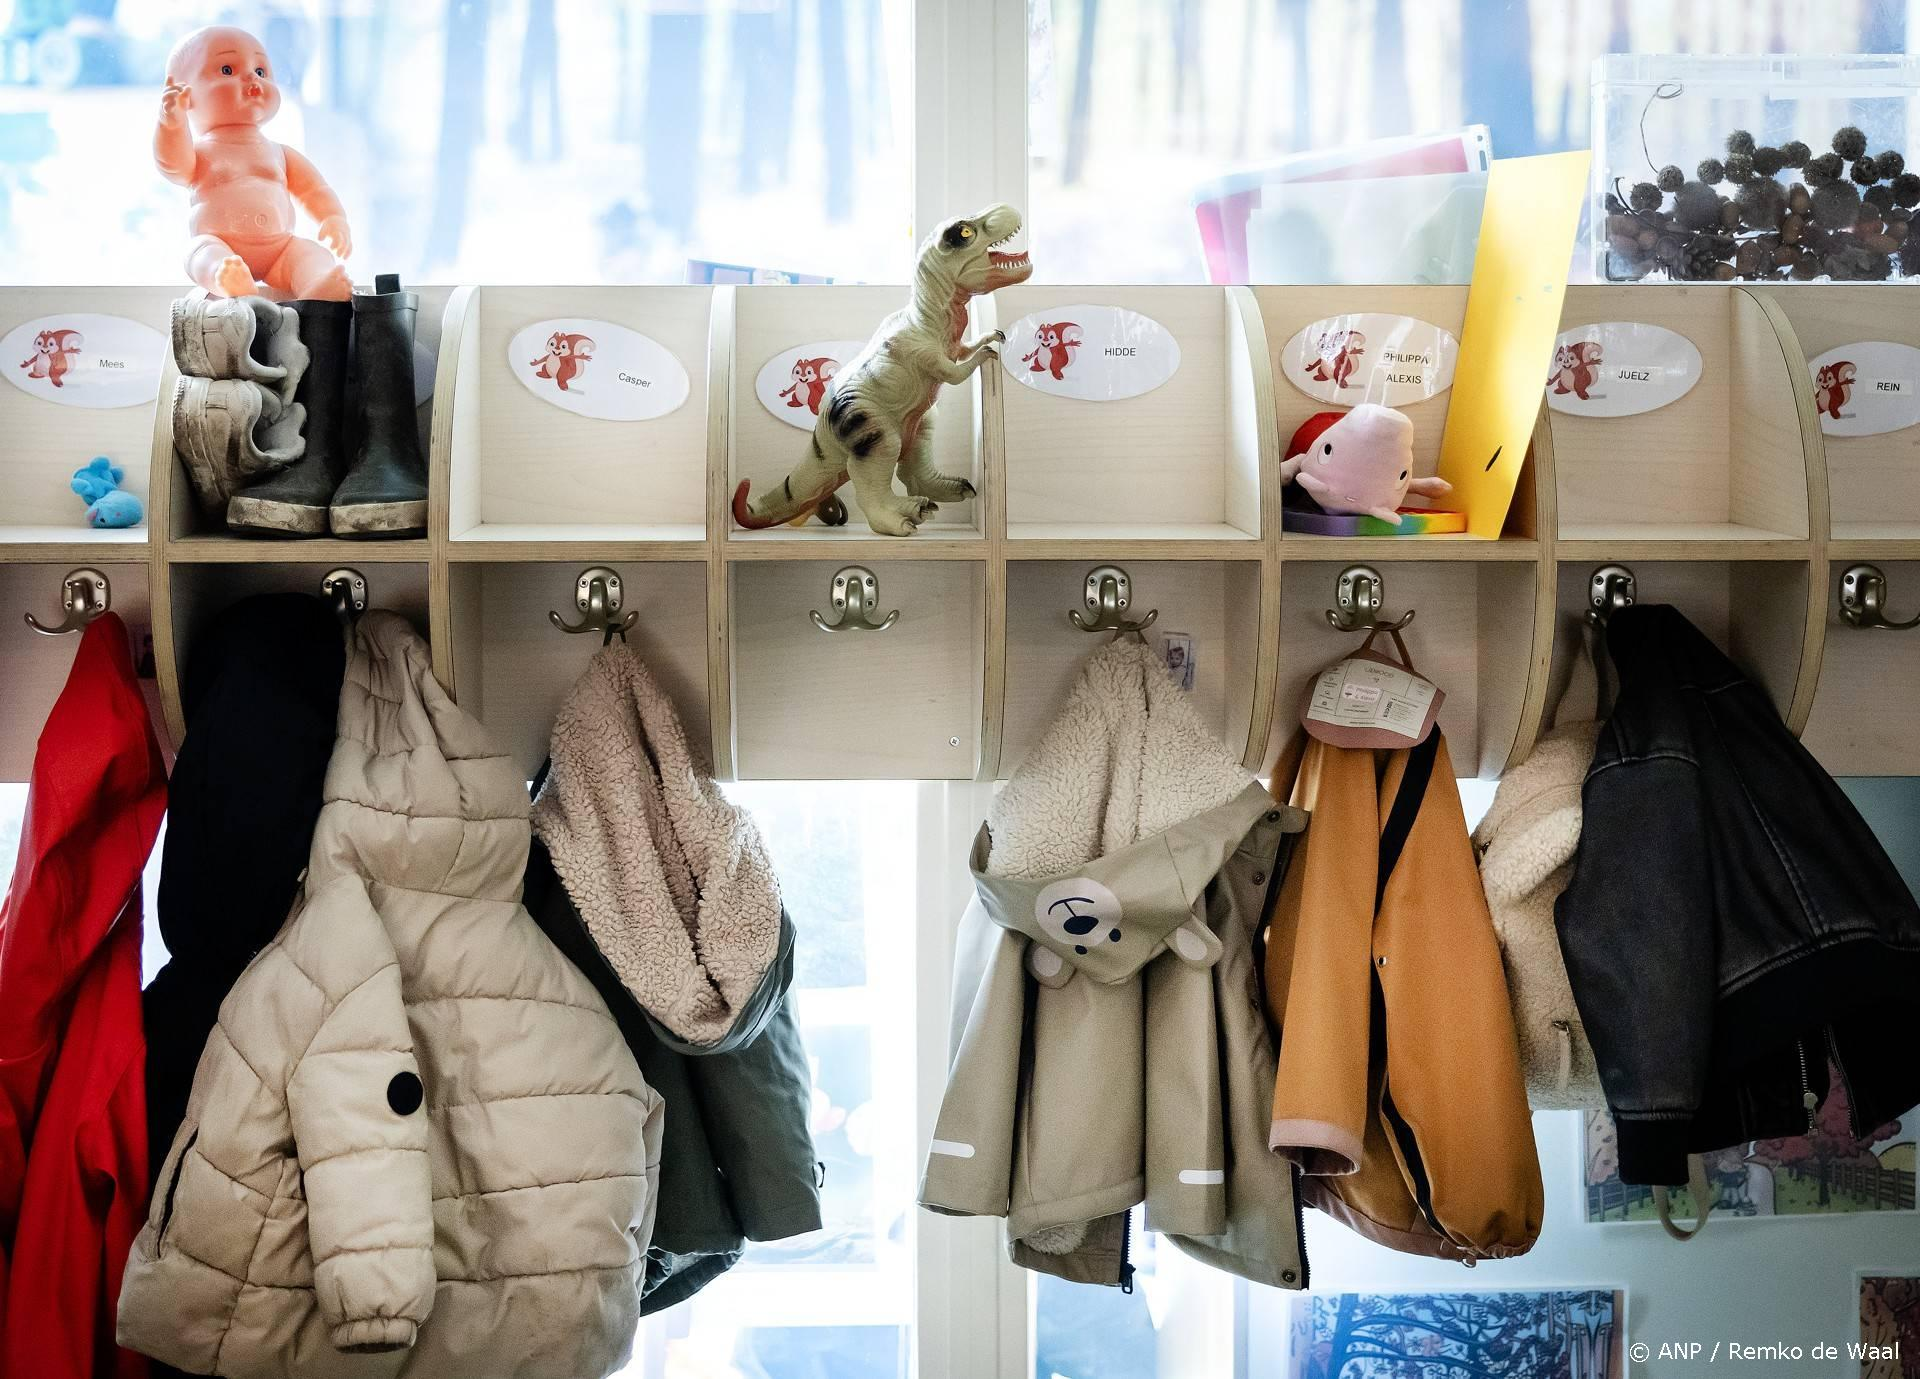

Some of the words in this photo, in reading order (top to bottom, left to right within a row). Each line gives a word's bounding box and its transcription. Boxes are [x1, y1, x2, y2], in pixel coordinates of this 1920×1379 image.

[1104, 347, 1137, 357] HIDDE
[99, 359, 125, 369] Mees
[1384, 352, 1429, 365] PHILIPPA
[618, 372, 652, 389] Casper
[1386, 373, 1422, 385] ALEXIS
[1618, 369, 1650, 382] JUELZ
[1876, 381, 1901, 392] REIN
